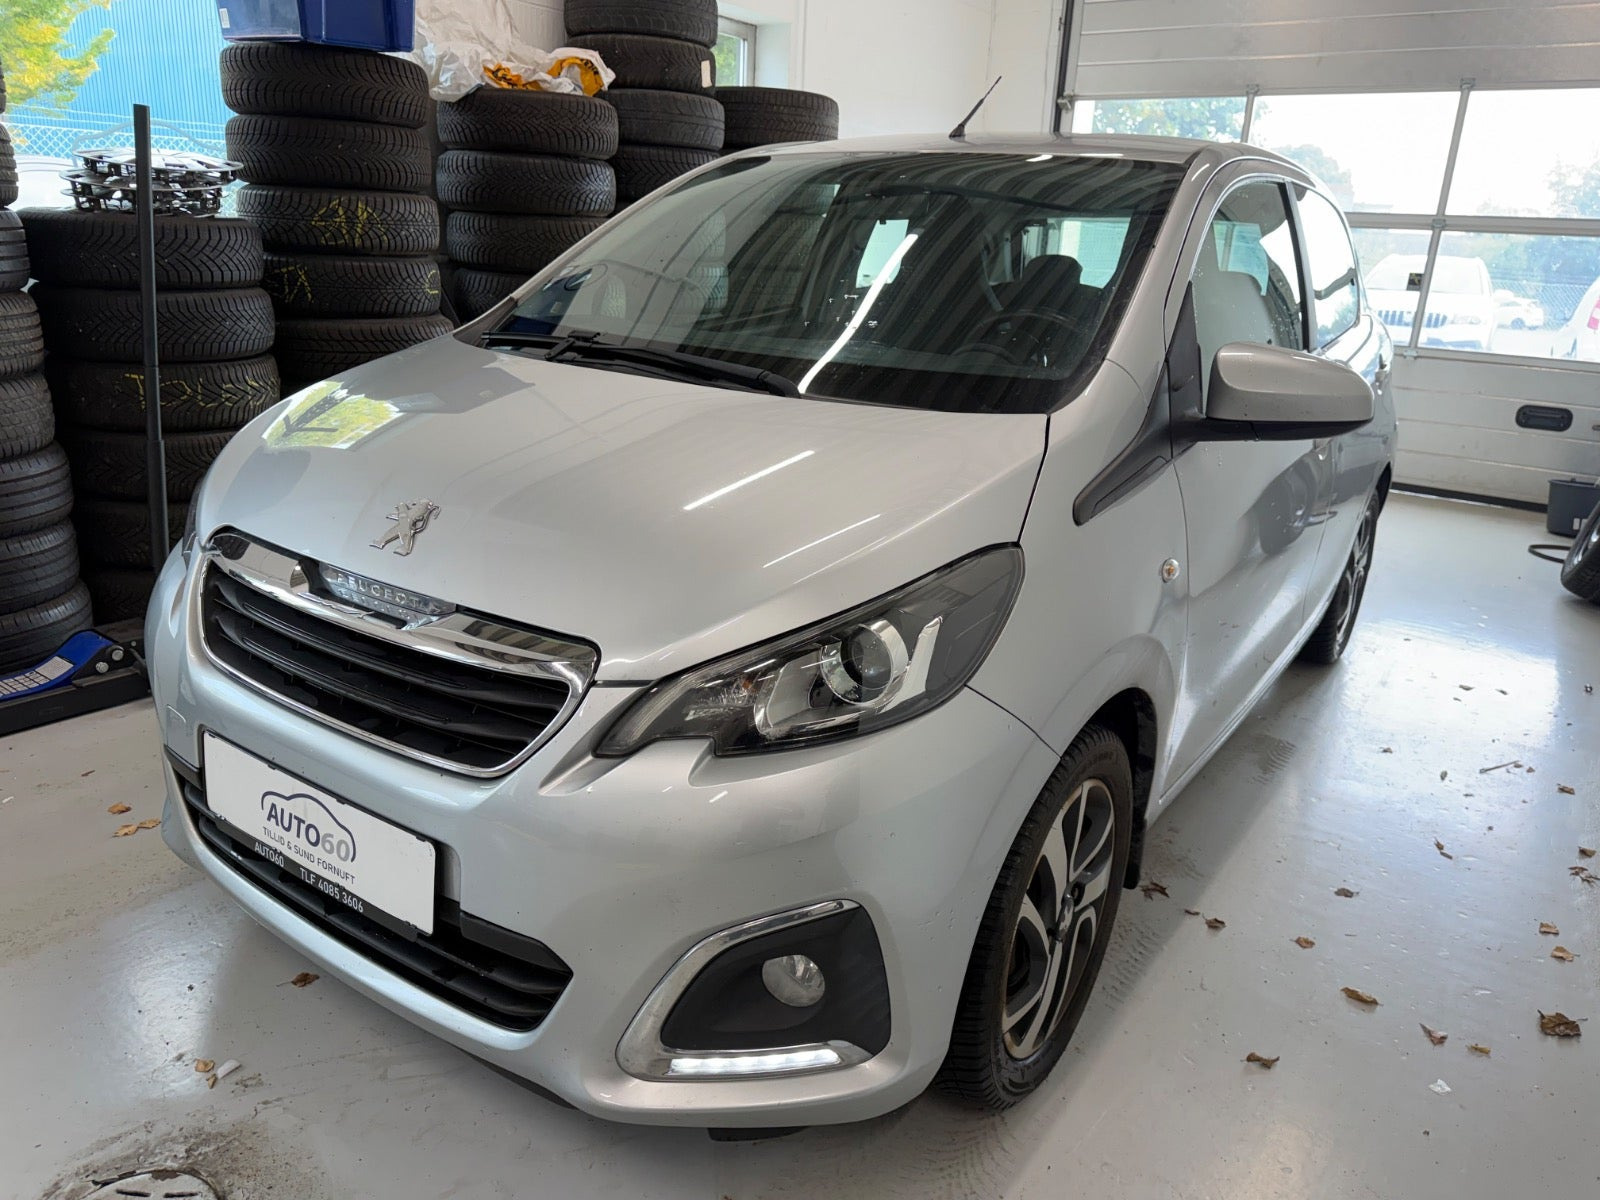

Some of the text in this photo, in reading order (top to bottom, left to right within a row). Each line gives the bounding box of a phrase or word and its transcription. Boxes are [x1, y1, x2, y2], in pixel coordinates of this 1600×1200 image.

[337, 573, 420, 607] PEUGEOT
[263, 826, 355, 884] TILLID & SUND FORNUFT
[266, 802, 350, 862] AUTO60
[254, 841, 364, 913] AUTO60 TLF 4085 3606
